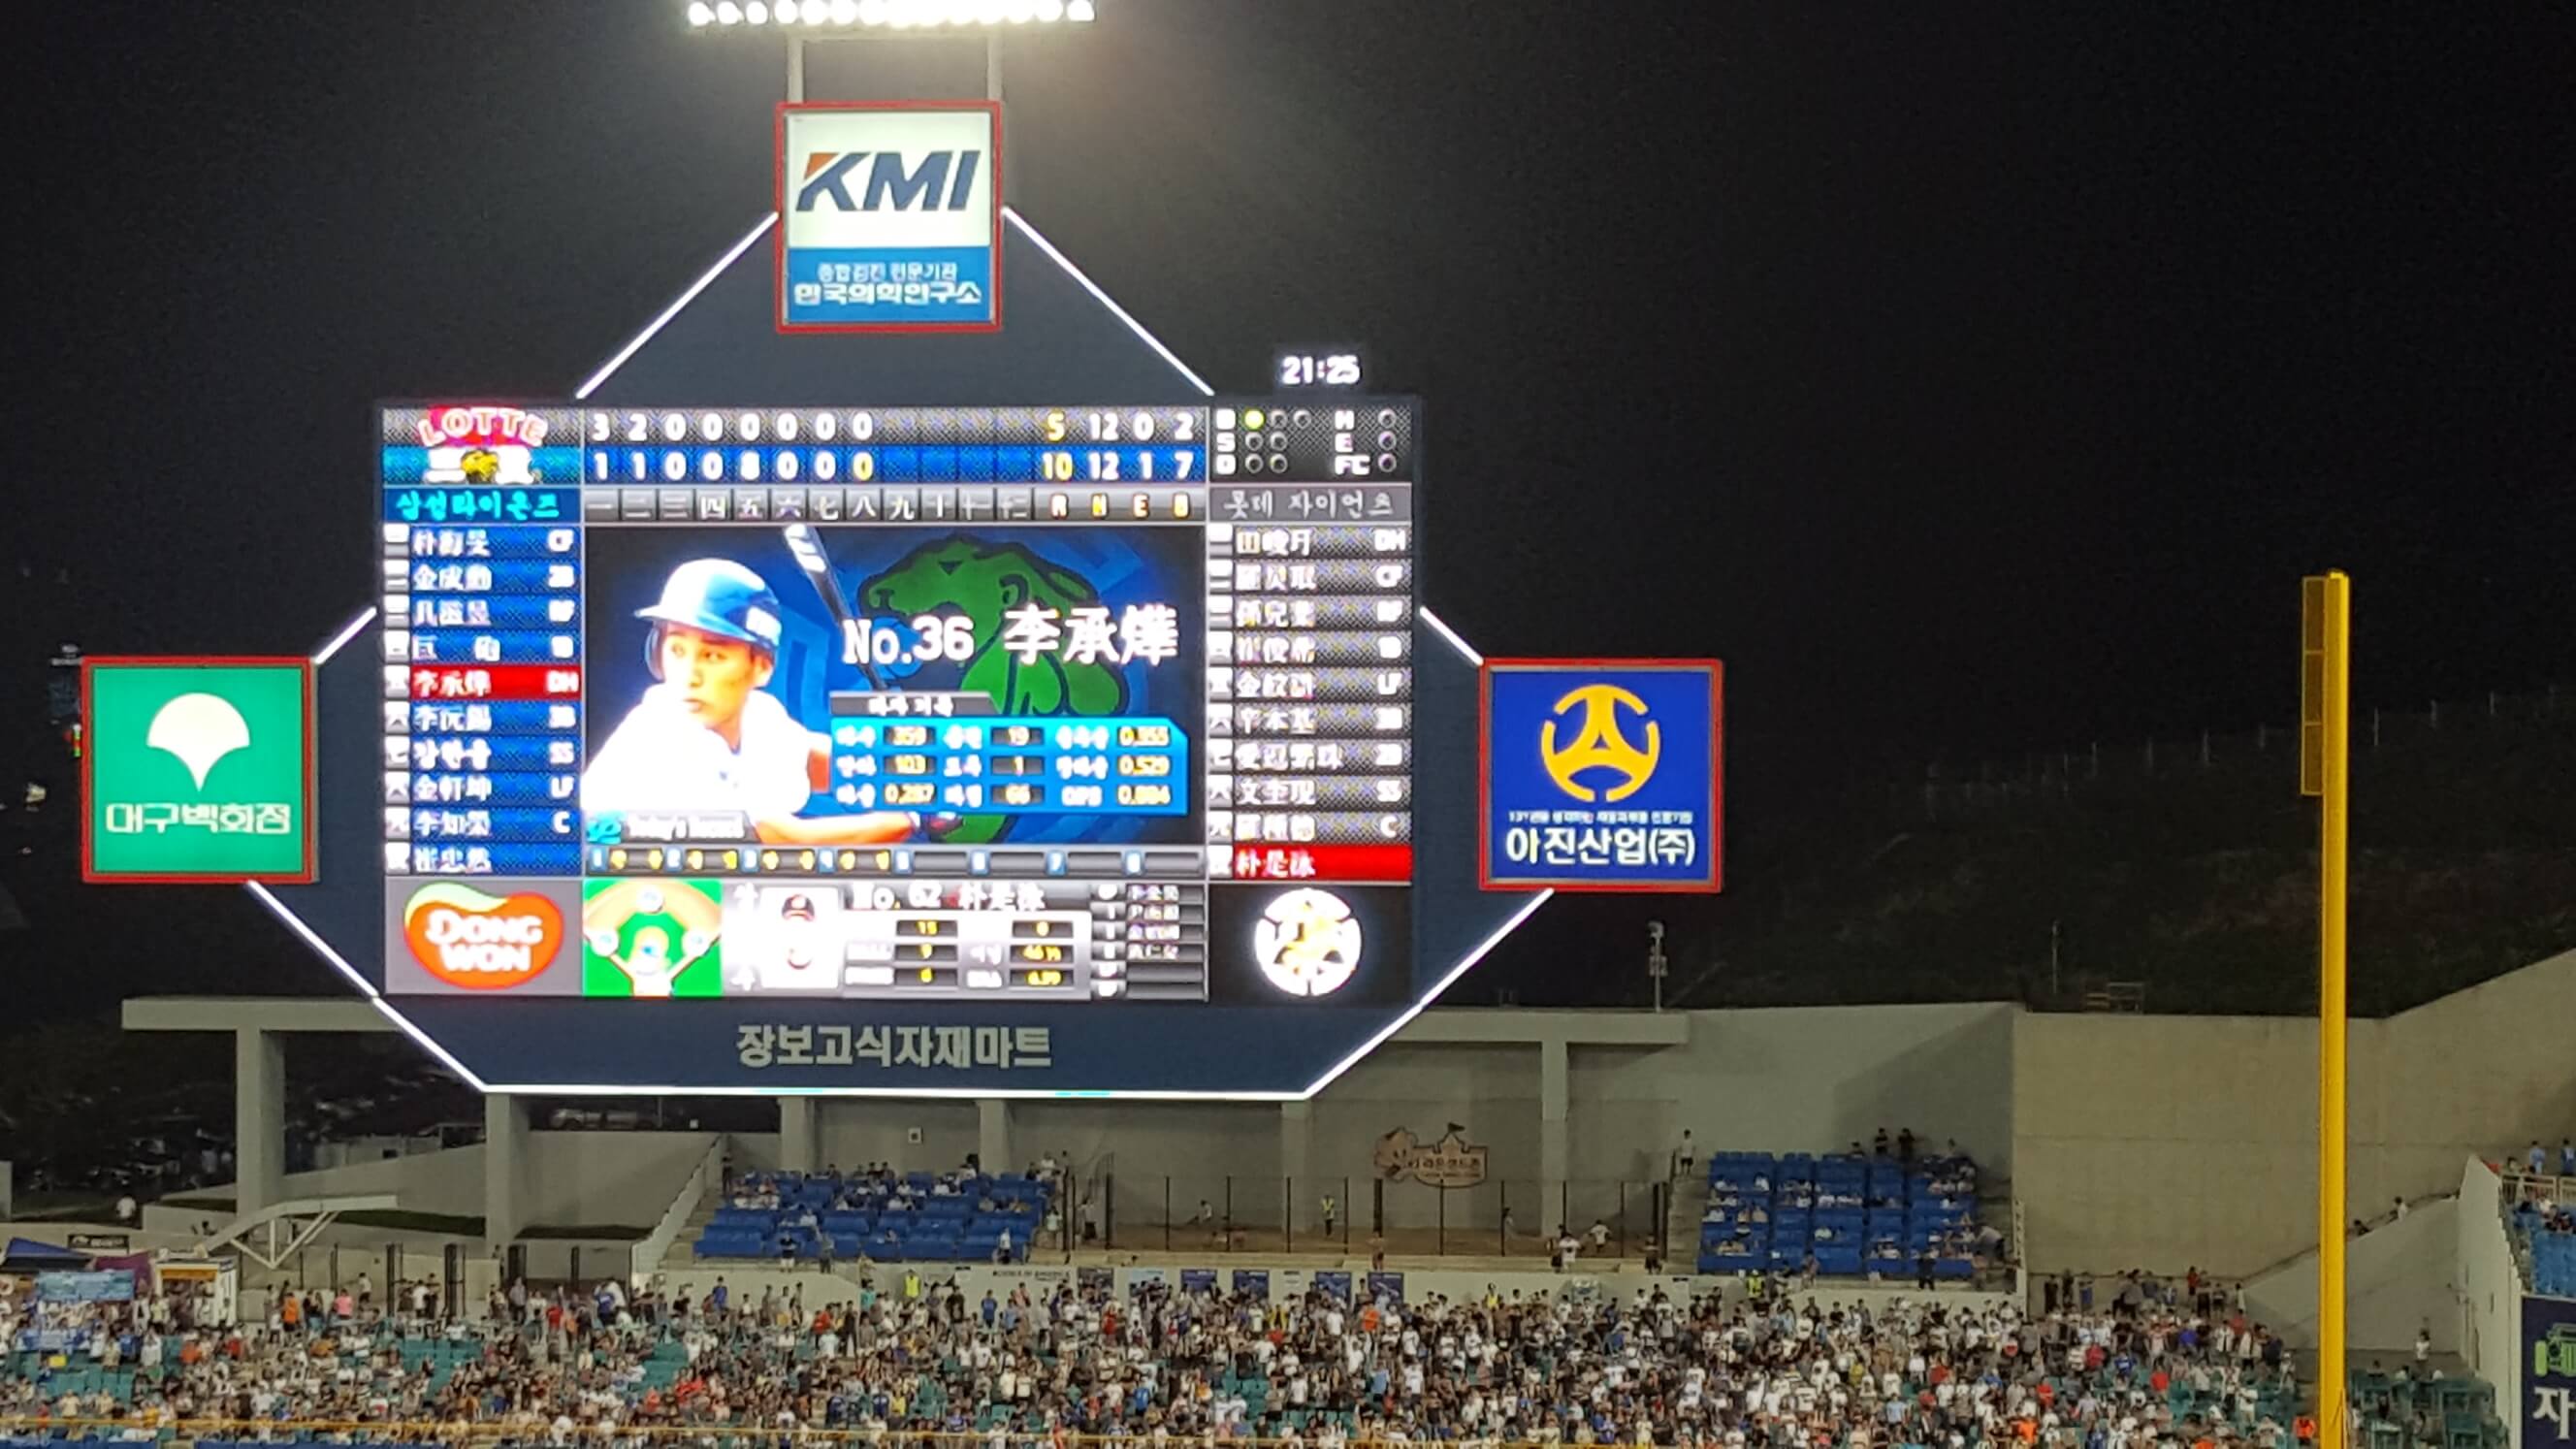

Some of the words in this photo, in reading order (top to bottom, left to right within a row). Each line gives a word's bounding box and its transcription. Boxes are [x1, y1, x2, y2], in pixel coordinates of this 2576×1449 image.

[795, 150, 981, 211] KMI
[793, 282, 982, 306] 한국의학연구소
[1281, 355, 1361, 385] 21:25
[417, 405, 548, 447] LOTTE
[594, 412, 610, 441] 3
[628, 412, 648, 441] 2
[664, 412, 687, 441] 0
[701, 412, 724, 441] 0
[739, 412, 760, 441] 0
[777, 412, 798, 441] 0
[816, 412, 836, 441] 0
[853, 412, 874, 441] 0
[1047, 410, 1065, 441] 5
[1088, 412, 1118, 440] 12
[1134, 412, 1154, 440] 0
[1174, 412, 1194, 440] 2
[1216, 432, 1237, 452] S
[1335, 433, 1354, 452] E
[594, 451, 608, 480] 1
[631, 451, 646, 480] 1
[664, 451, 687, 480] 0
[701, 451, 724, 480] 0
[739, 451, 760, 480] 8
[777, 451, 798, 480] 0
[816, 451, 836, 480] 0
[853, 451, 874, 480] 0
[1043, 452, 1074, 480] 10
[1088, 452, 1118, 480] 12
[1140, 452, 1152, 479] 1
[1174, 452, 1194, 480] 7
[1335, 455, 1370, 475] FC
[662, 497, 688, 517] 三
[700, 497, 726, 520] 四
[775, 496, 801, 518] 六
[815, 496, 838, 520] 七
[852, 495, 876, 518] 八
[889, 497, 915, 520] 九
[1224, 490, 1273, 519] 롯데
[1287, 490, 1394, 519] 자이언츠
[843, 616, 975, 663] No.36
[106, 803, 291, 834] 대구백화점
[552, 811, 570, 833] C
[1380, 816, 1400, 838] C
[1506, 827, 1695, 866] 아진산업(주)
[425, 908, 543, 945] DONG
[440, 944, 531, 973] WON
[737, 1025, 1051, 1069] 장보고식자재마트
